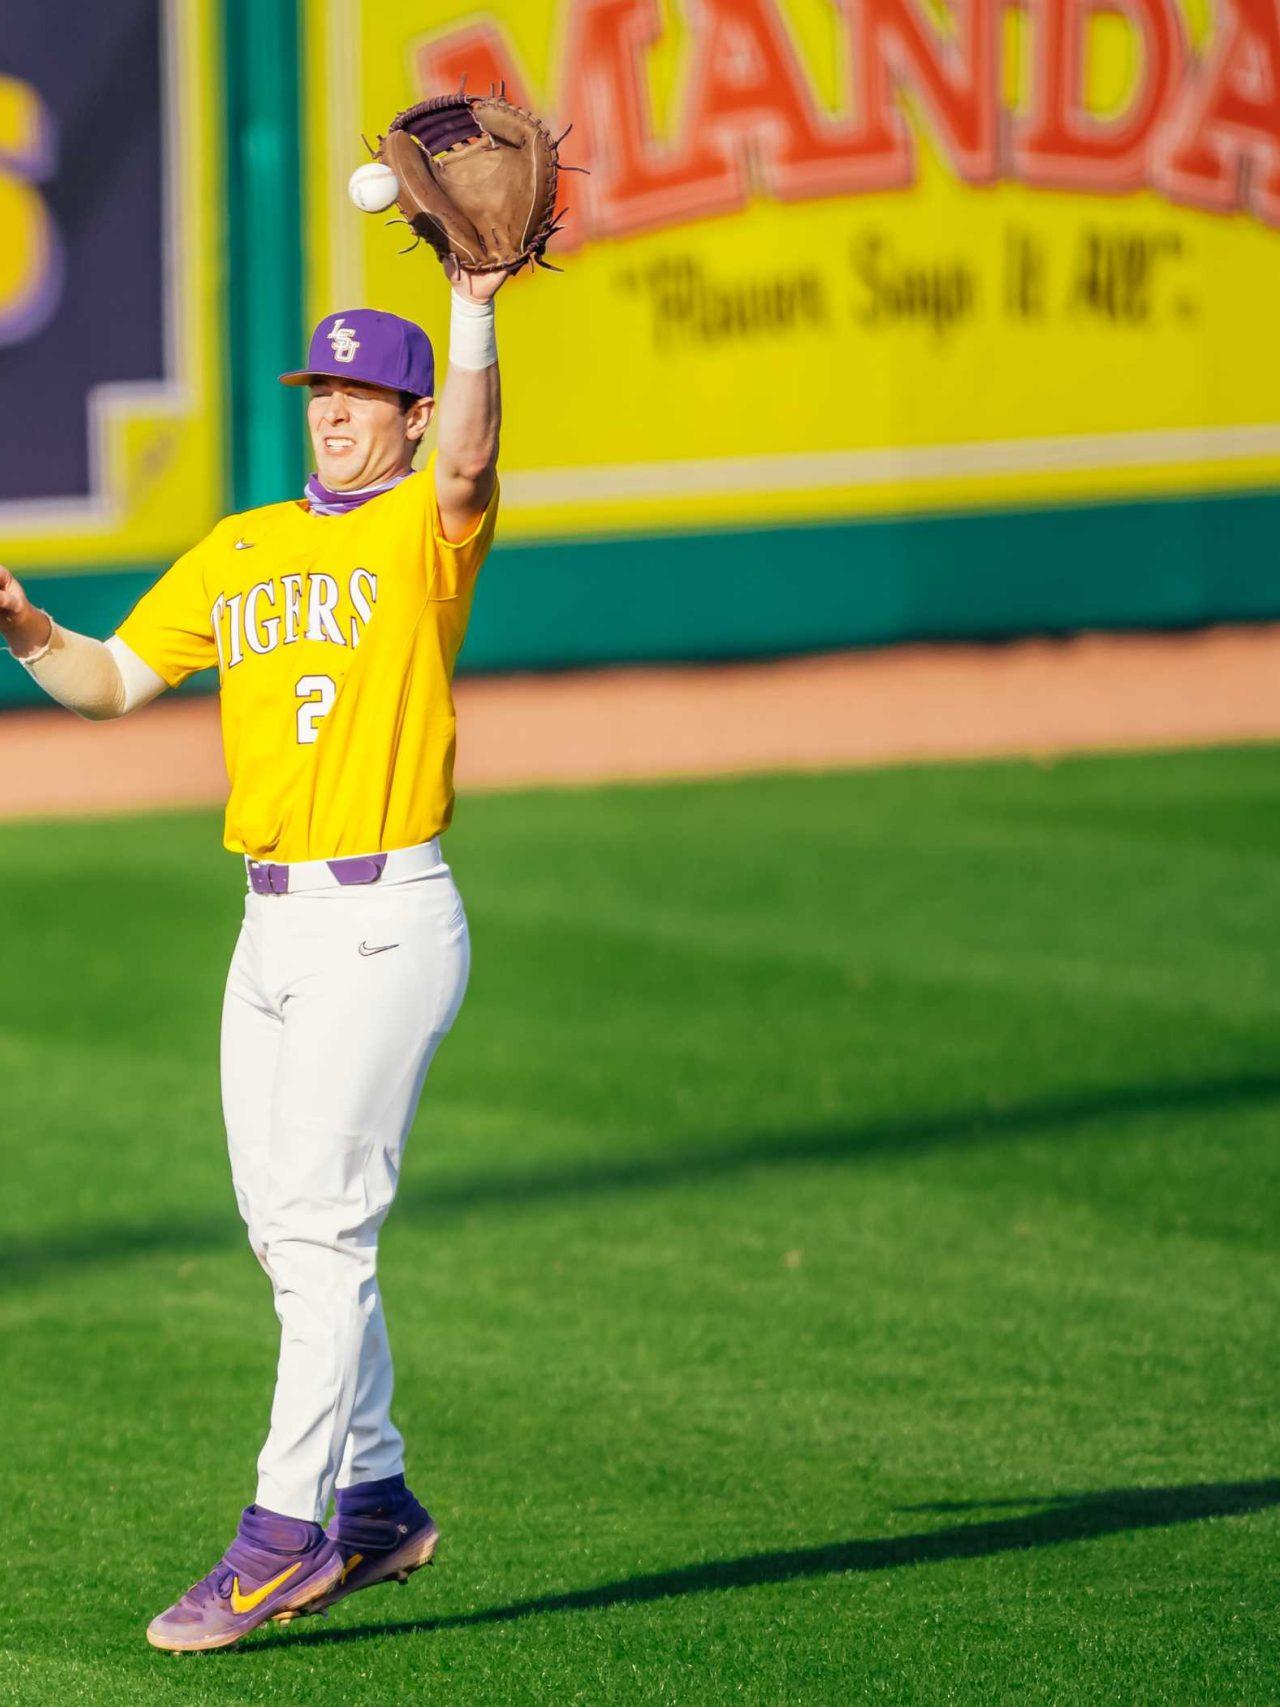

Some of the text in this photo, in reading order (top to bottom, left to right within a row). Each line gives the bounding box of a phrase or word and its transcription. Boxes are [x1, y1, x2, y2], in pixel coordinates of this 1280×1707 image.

[327, 318, 361, 363] LSU
[210, 567, 378, 680] TIGERS
[294, 674, 338, 745] 2
